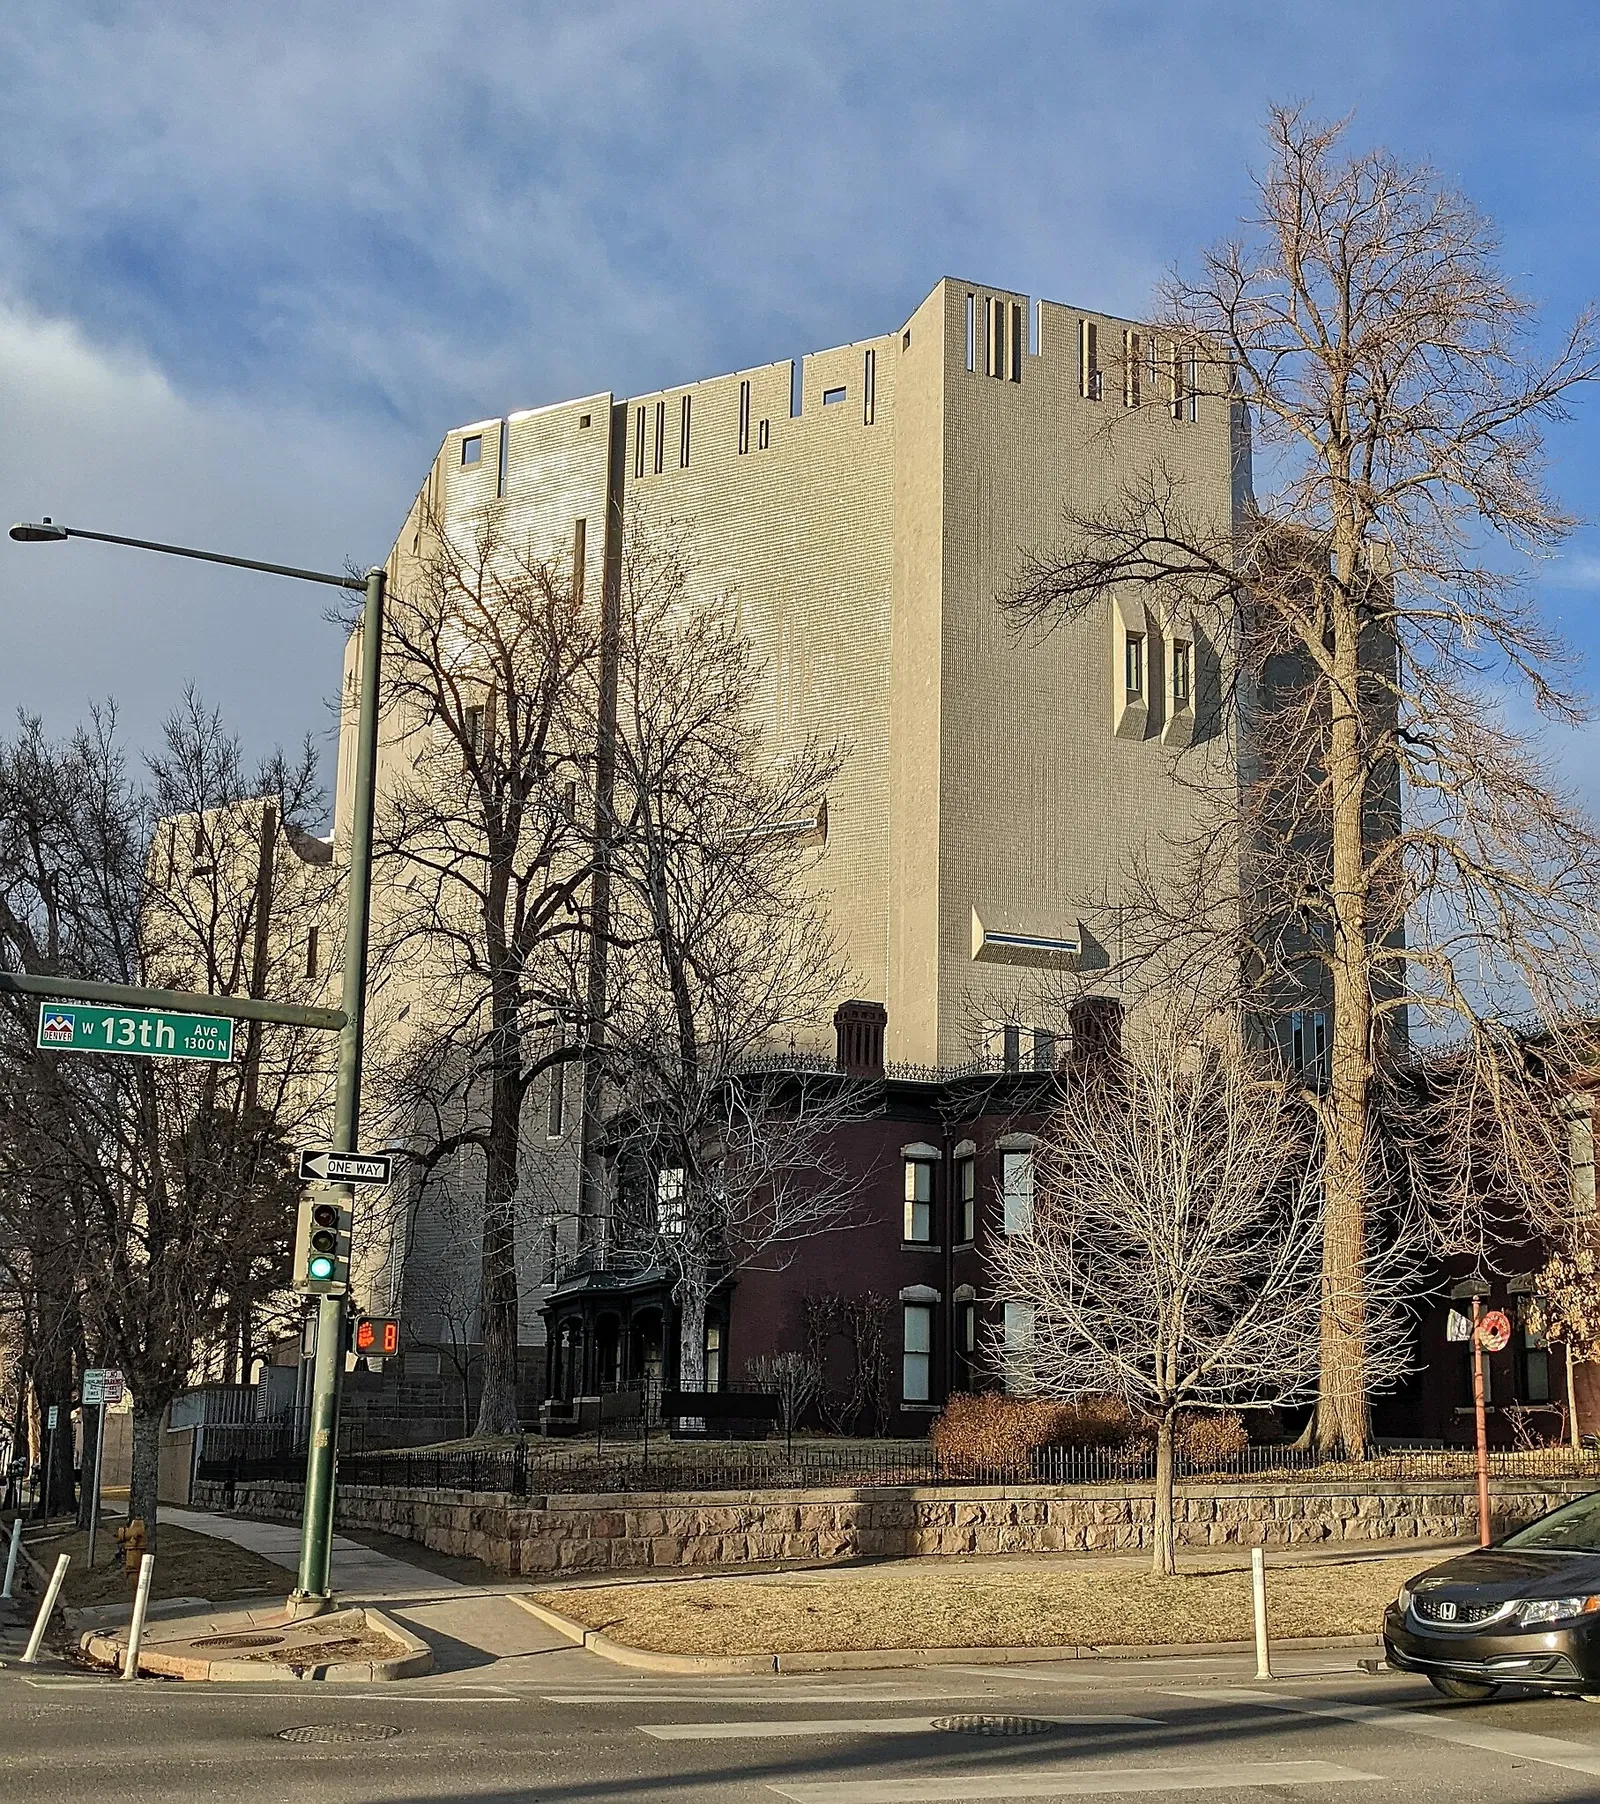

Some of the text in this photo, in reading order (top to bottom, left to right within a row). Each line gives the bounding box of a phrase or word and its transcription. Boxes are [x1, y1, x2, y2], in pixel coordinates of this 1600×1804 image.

[44, 1031, 72, 1041] DENVER
[82, 1017, 218, 1049] W 13th Ave
[184, 1037, 227, 1051] 1300 N
[328, 1161, 380, 1175] ONE WAY
[385, 1324, 396, 1350] 8
